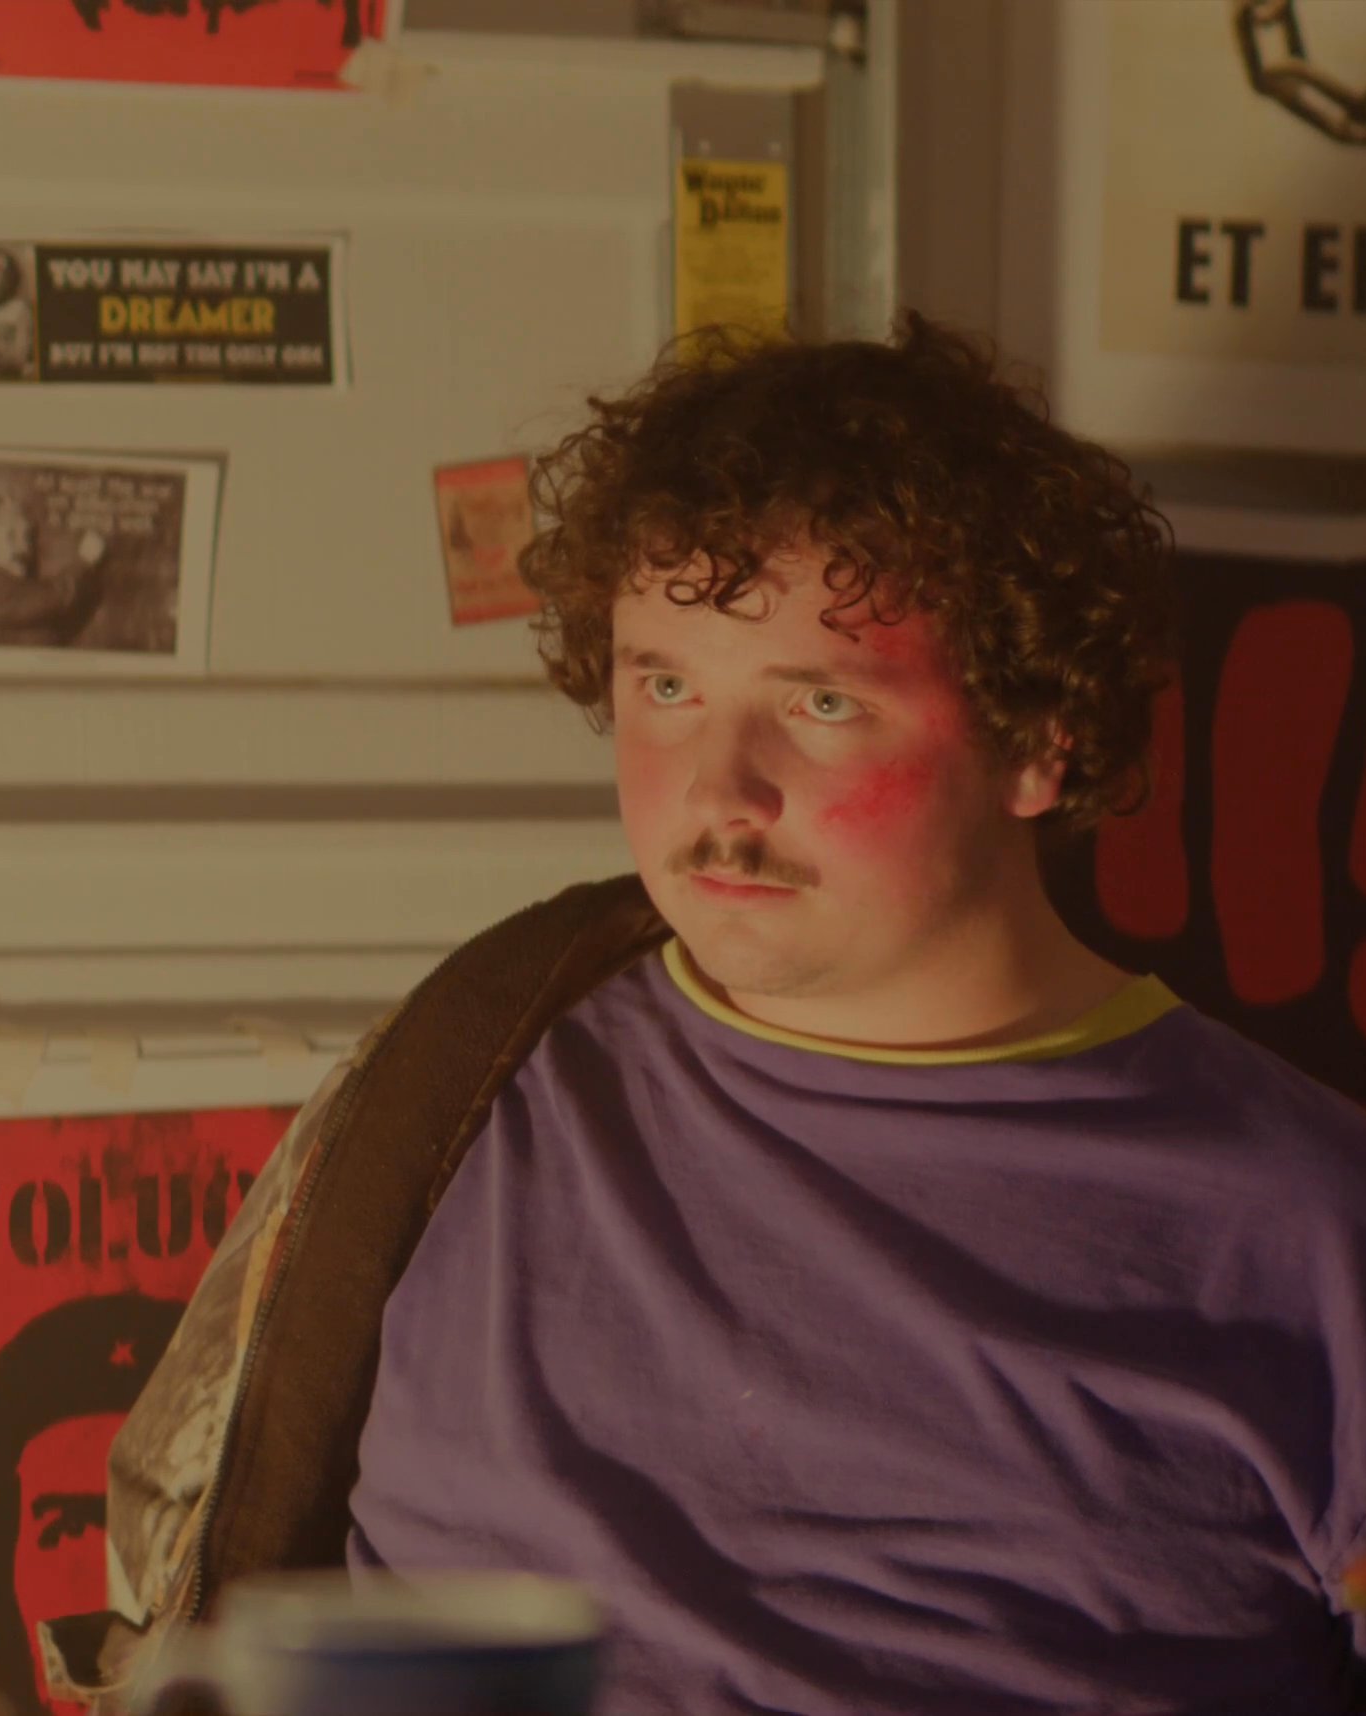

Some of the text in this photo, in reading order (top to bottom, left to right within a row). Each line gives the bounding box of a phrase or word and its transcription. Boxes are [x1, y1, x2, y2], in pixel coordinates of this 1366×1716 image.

[48, 258, 321, 289] YOU MAY SAY I'M A
[1175, 217, 1266, 307] ET
[100, 295, 276, 335] DREAMER
[49, 342, 94, 367] BUT
